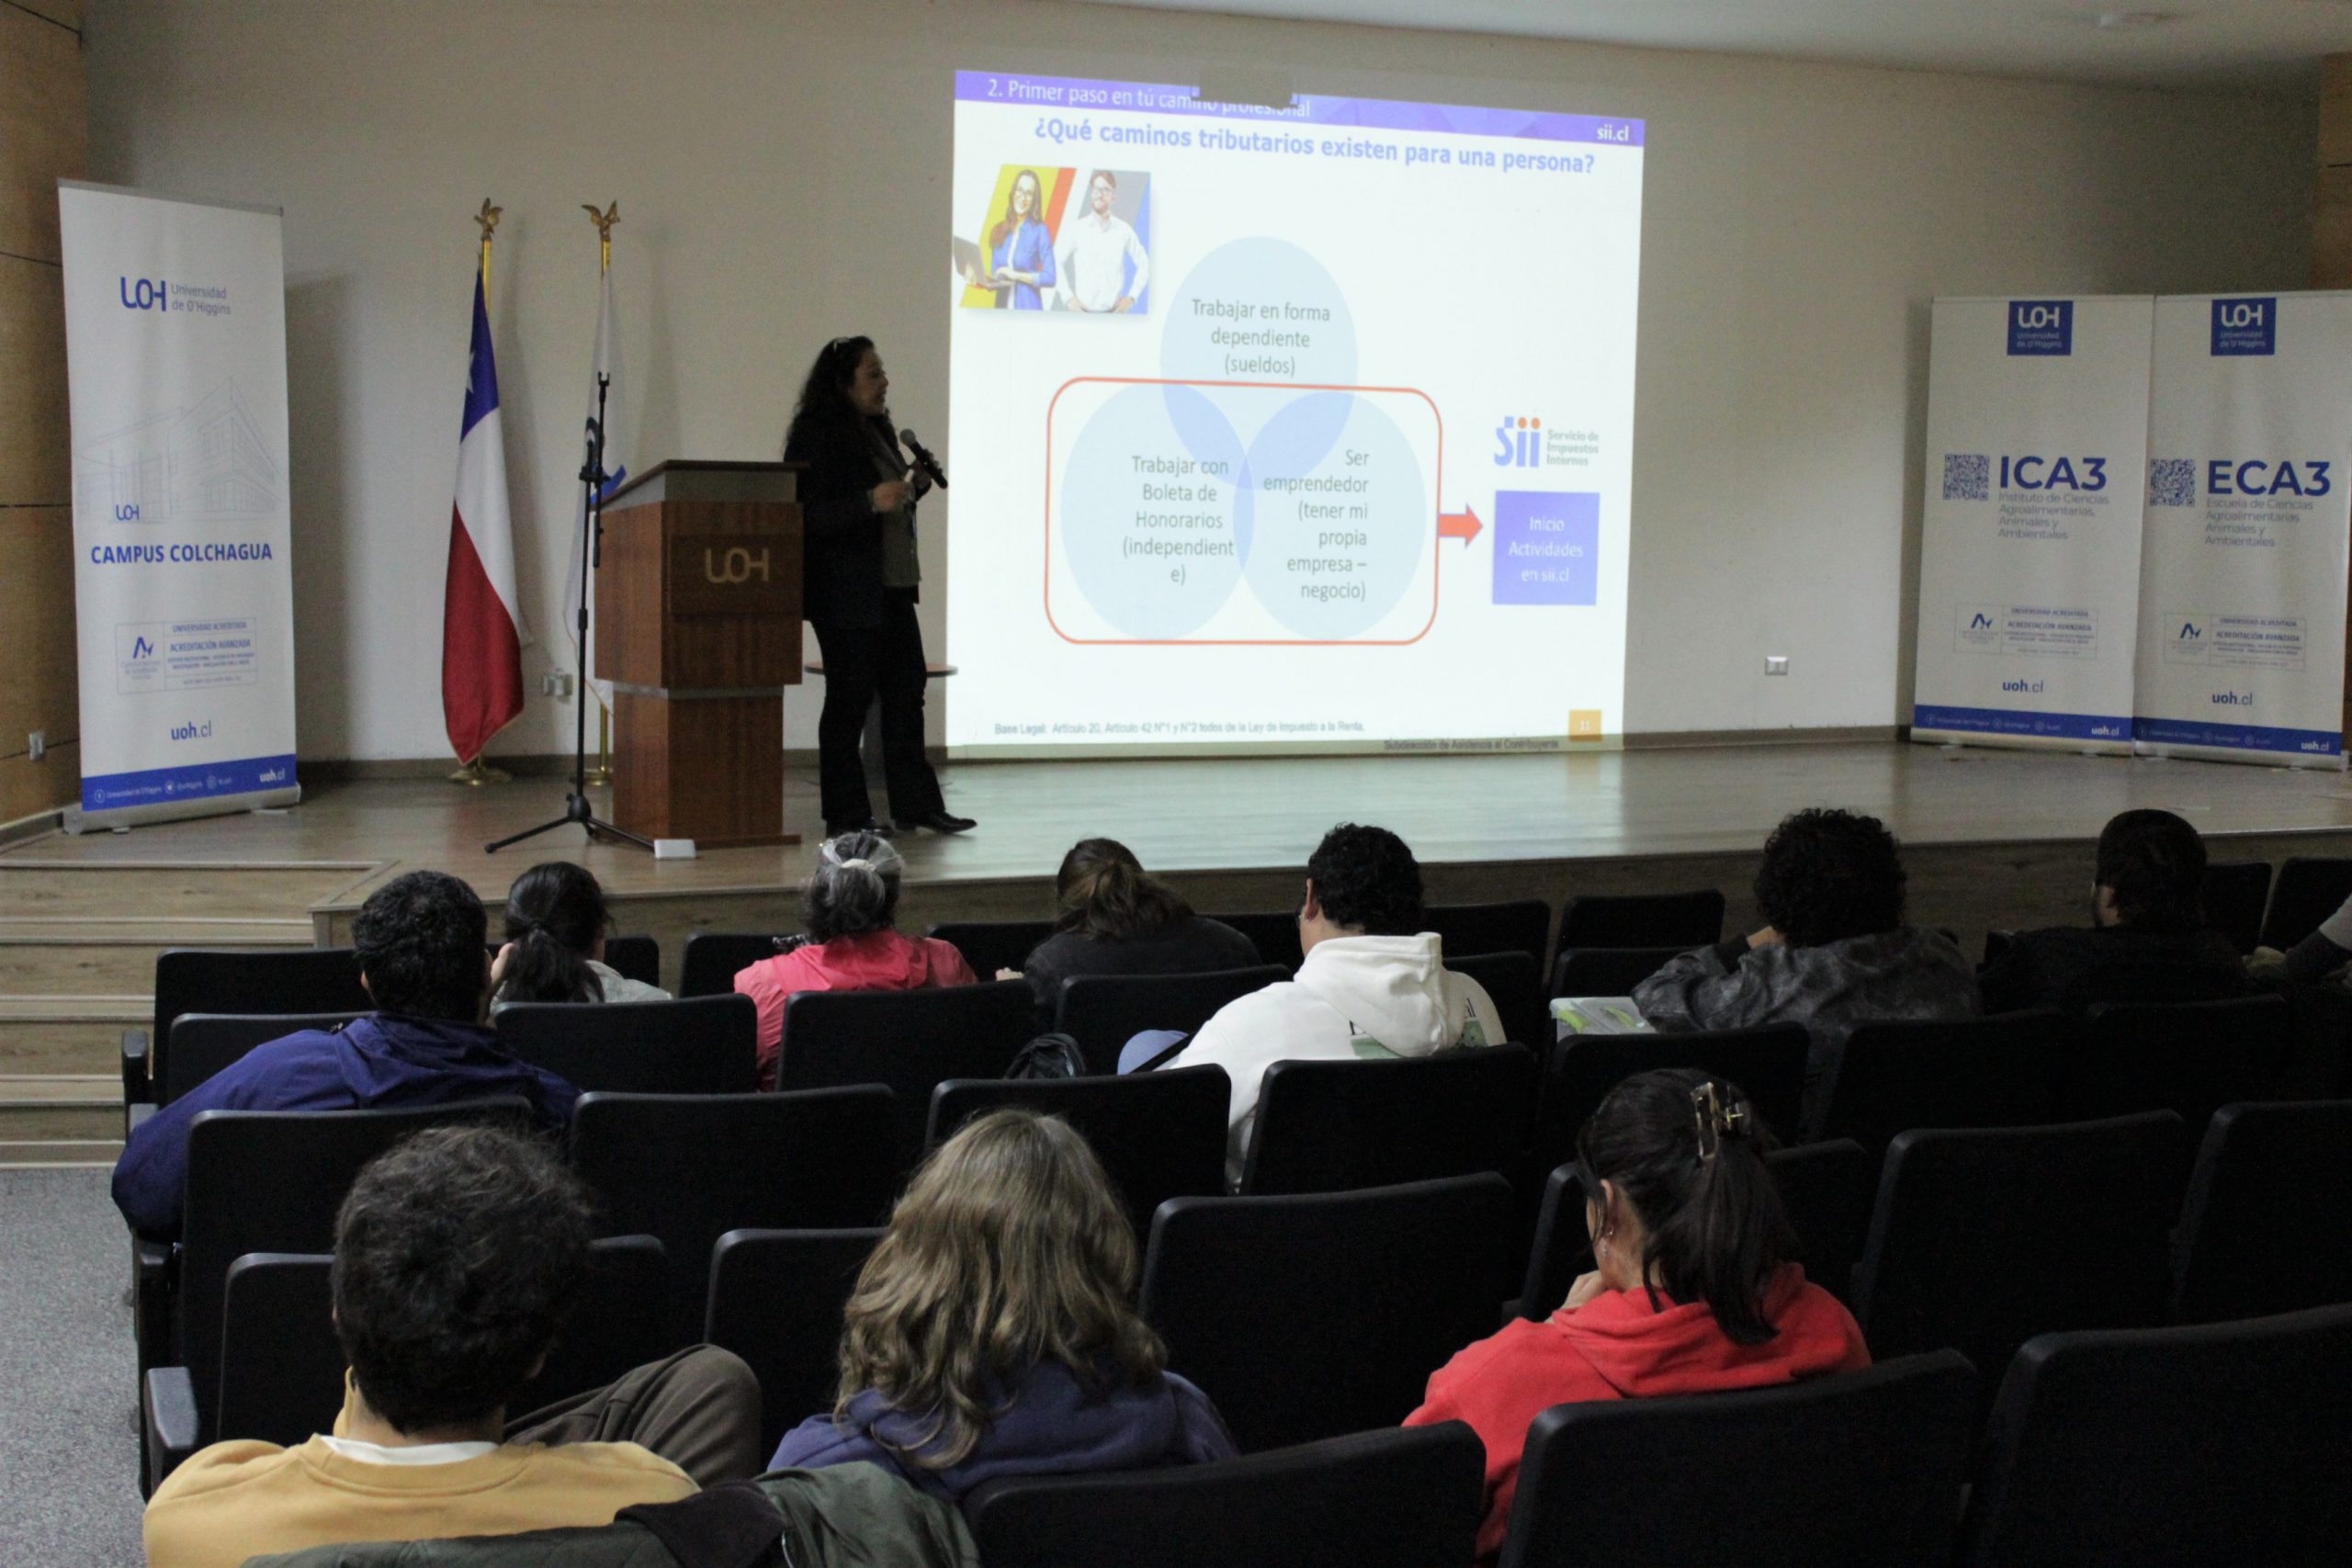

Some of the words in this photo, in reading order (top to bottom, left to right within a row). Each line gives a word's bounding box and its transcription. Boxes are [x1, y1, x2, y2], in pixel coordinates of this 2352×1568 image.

[988, 79, 1003, 96] 2.
[1009, 80, 1064, 101] Primer
[1069, 87, 1108, 107] paso
[1112, 89, 1133, 106] en
[1136, 86, 1154, 107] tú
[1596, 124, 1629, 142] sii.cl
[1035, 118, 1091, 144] ¿Qué
[1100, 122, 1192, 147] caminos
[1199, 128, 1314, 154] tributarios
[1320, 137, 1397, 161] existen
[1405, 144, 1451, 166] para
[1458, 148, 1496, 167] una
[1502, 152, 1595, 174] persona?
[171, 283, 227, 299] Universidad
[172, 300, 184, 310] de
[1192, 299, 1255, 321] Trabajar
[1260, 305, 1279, 320] en
[1284, 302, 1330, 321] forma
[1211, 327, 1310, 348] dependiente
[1225, 354, 1295, 378] (sueldos)
[1547, 429, 1586, 442] Servicio
[1588, 431, 1600, 442] de
[1547, 442, 1600, 456] Impuestos
[1345, 449, 1370, 467] Ser
[1547, 455, 1589, 467] Internos
[1132, 456, 1196, 478] Trabajar
[1201, 459, 1229, 475] con
[2000, 456, 2107, 491] ICA3
[1263, 474, 1369, 495] emprendedor
[2208, 460, 2331, 496] ECA3
[1143, 483, 1193, 502] Boleta
[1197, 483, 1217, 502] de
[1998, 492, 2044, 502] Instituto
[2045, 492, 2062, 503] de
[2063, 493, 2109, 504] Ciencias
[1297, 500, 1344, 522] (tener
[1350, 502, 1369, 520] mi
[2206, 498, 2250, 508] Escuela
[2251, 499, 2266, 509] de
[2267, 500, 2313, 510] Ciencias
[1136, 511, 1223, 529] Honorarios
[1529, 516, 1566, 532] Inicio
[1998, 516, 2050, 527] Animales
[2052, 519, 2059, 529] y
[1997, 528, 2069, 540] Ambientales
[2205, 524, 2257, 535] Animales
[2258, 526, 2266, 536] y
[1123, 536, 1234, 558] (independient
[1318, 529, 1367, 549] propia
[2205, 536, 2276, 547] Ambientales
[91, 545, 164, 564] CAMPUS
[170, 543, 273, 562] COLCHAGUA
[1509, 541, 1584, 558] Actividades
[1170, 564, 1186, 586] e)
[1286, 558, 1352, 575] empresa
[1521, 570, 1538, 582] en
[1541, 567, 1570, 583] sii.cl
[1300, 581, 1366, 603] negocio)
[2003, 679, 2043, 693] uoh.cl
[2212, 691, 2253, 705] uoh.cl
[171, 720, 211, 740] uoh.cl
[995, 722, 1018, 734] Base
[1225, 722, 1237, 733] de
[1248, 721, 1264, 735] Ley
[1266, 721, 1277, 733] de
[2301, 740, 2329, 752] uoh.cl
[259, 768, 286, 783] uoh.cl
